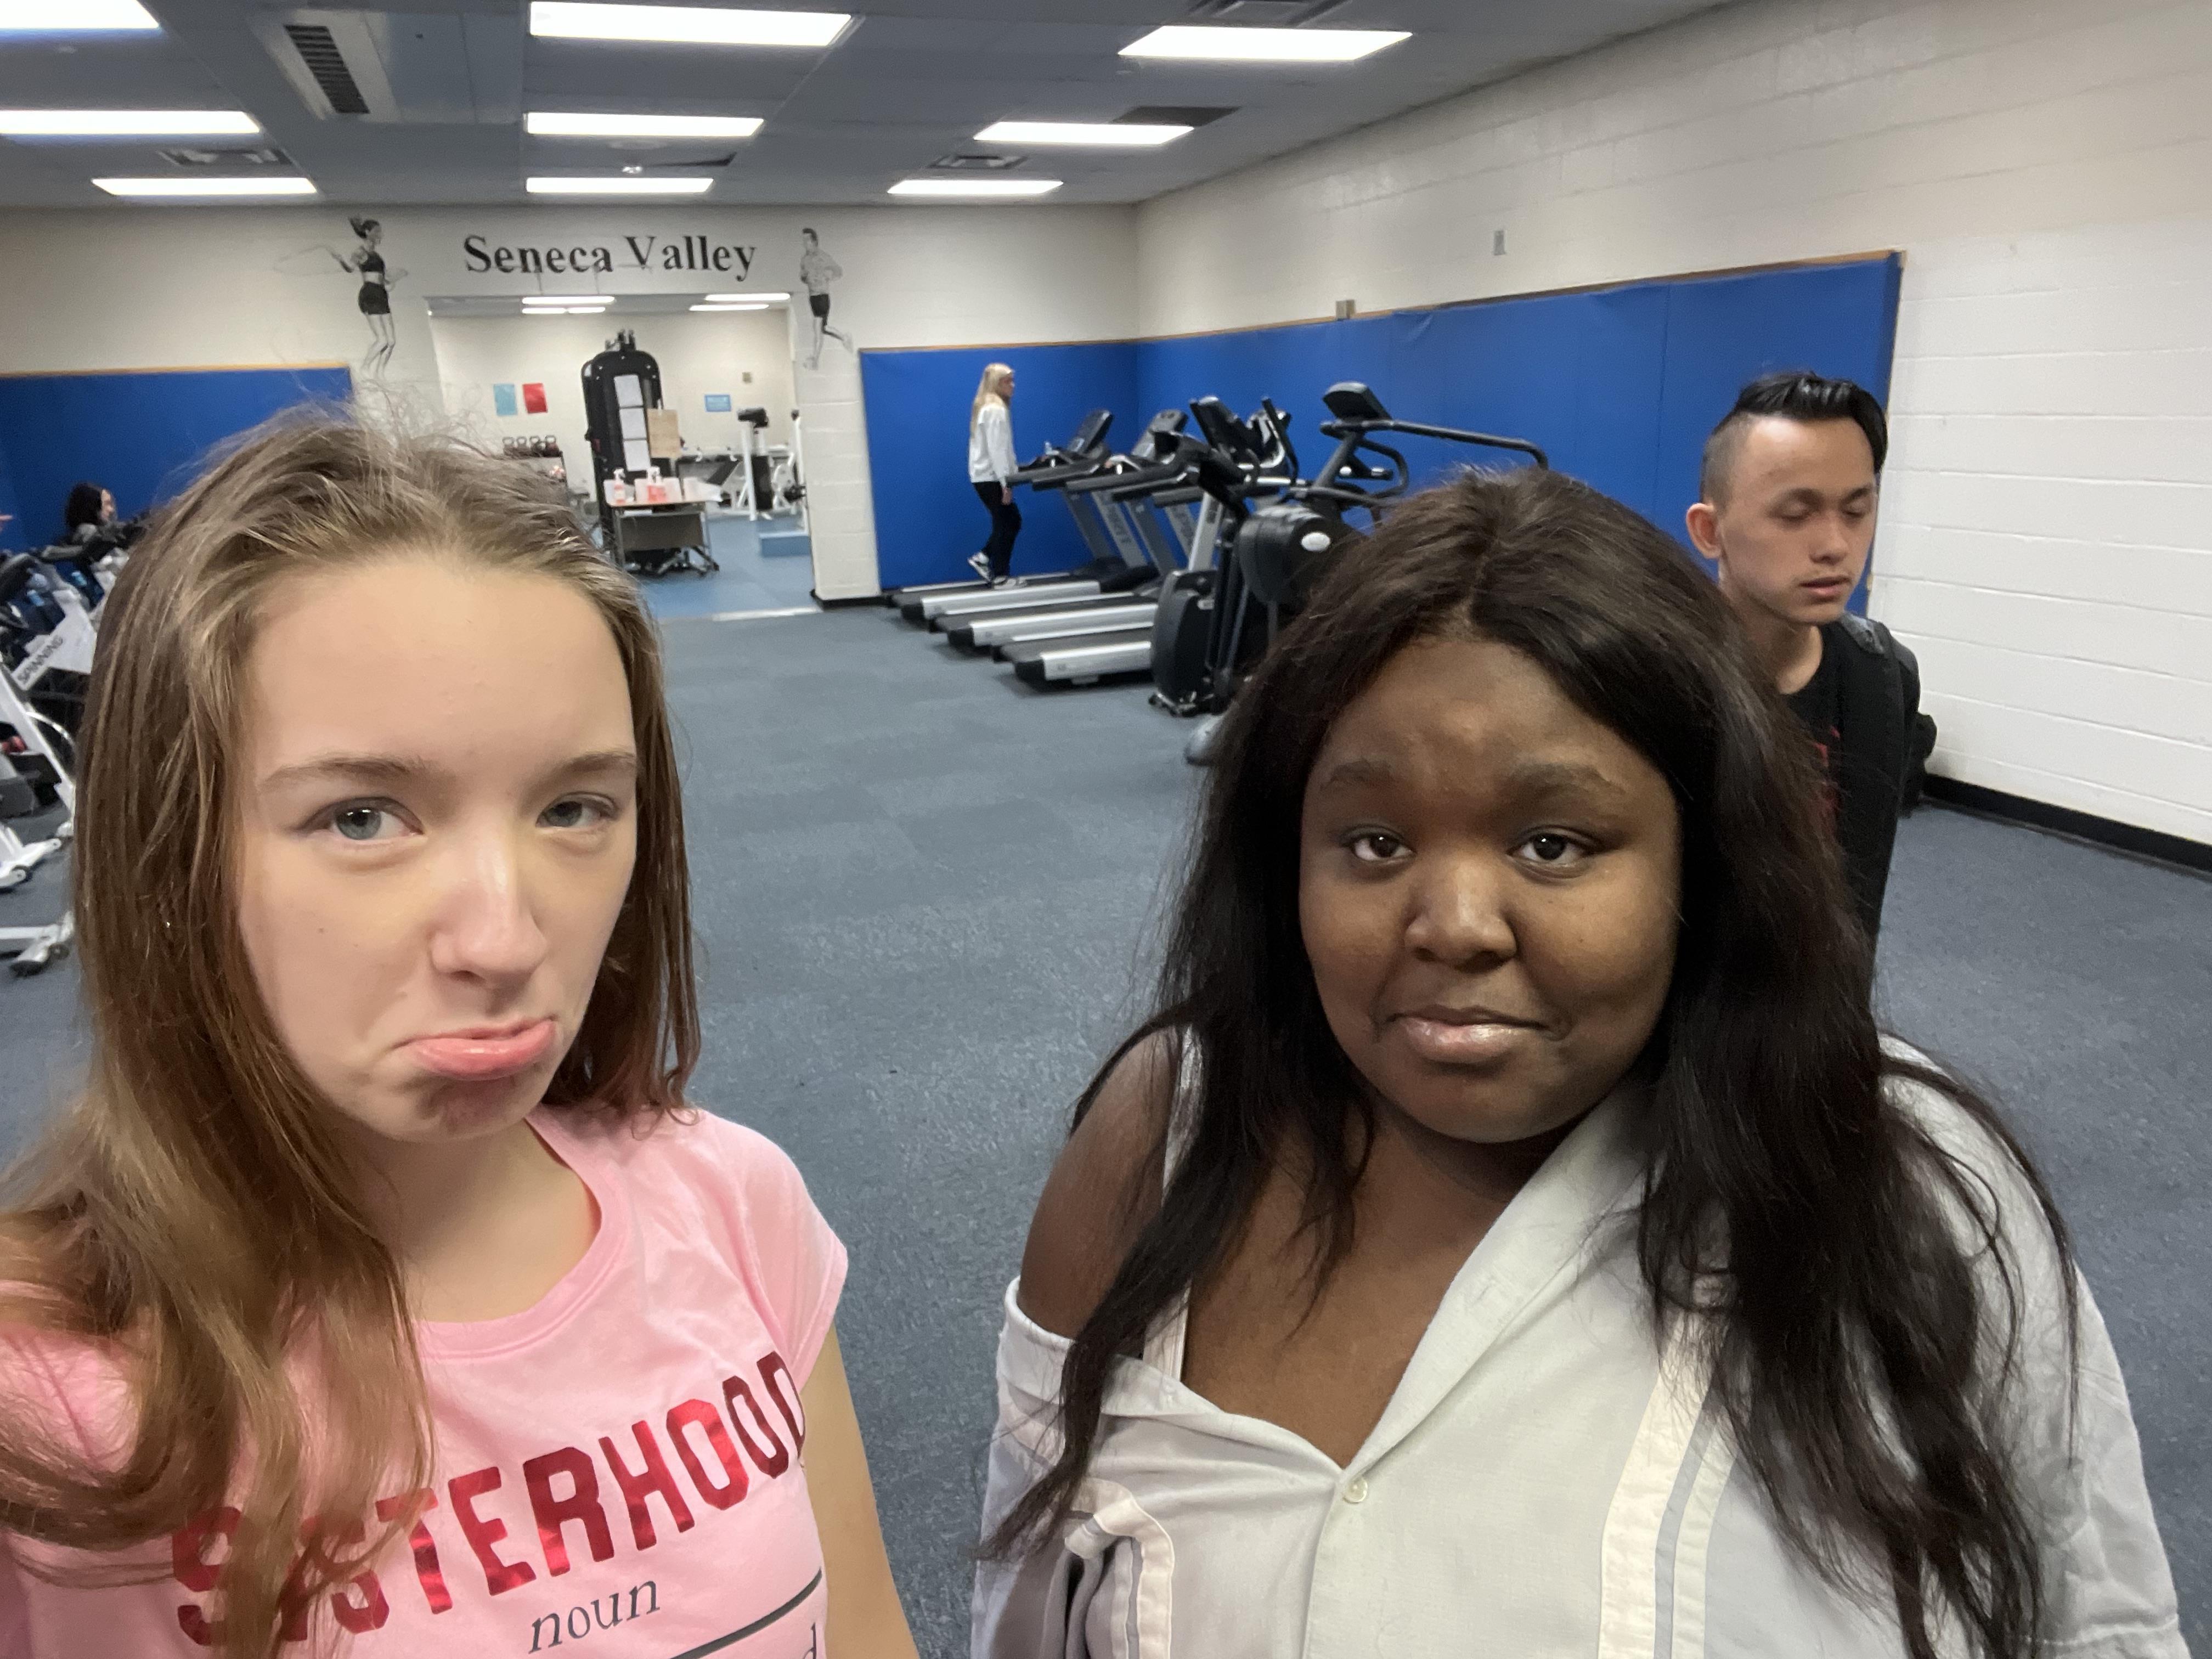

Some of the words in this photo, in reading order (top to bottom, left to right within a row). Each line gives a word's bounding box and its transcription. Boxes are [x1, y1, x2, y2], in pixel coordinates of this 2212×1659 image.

[464, 234, 614, 274] Seneca
[623, 235, 757, 281] Valley
[528, 1581, 661, 1654] noun
